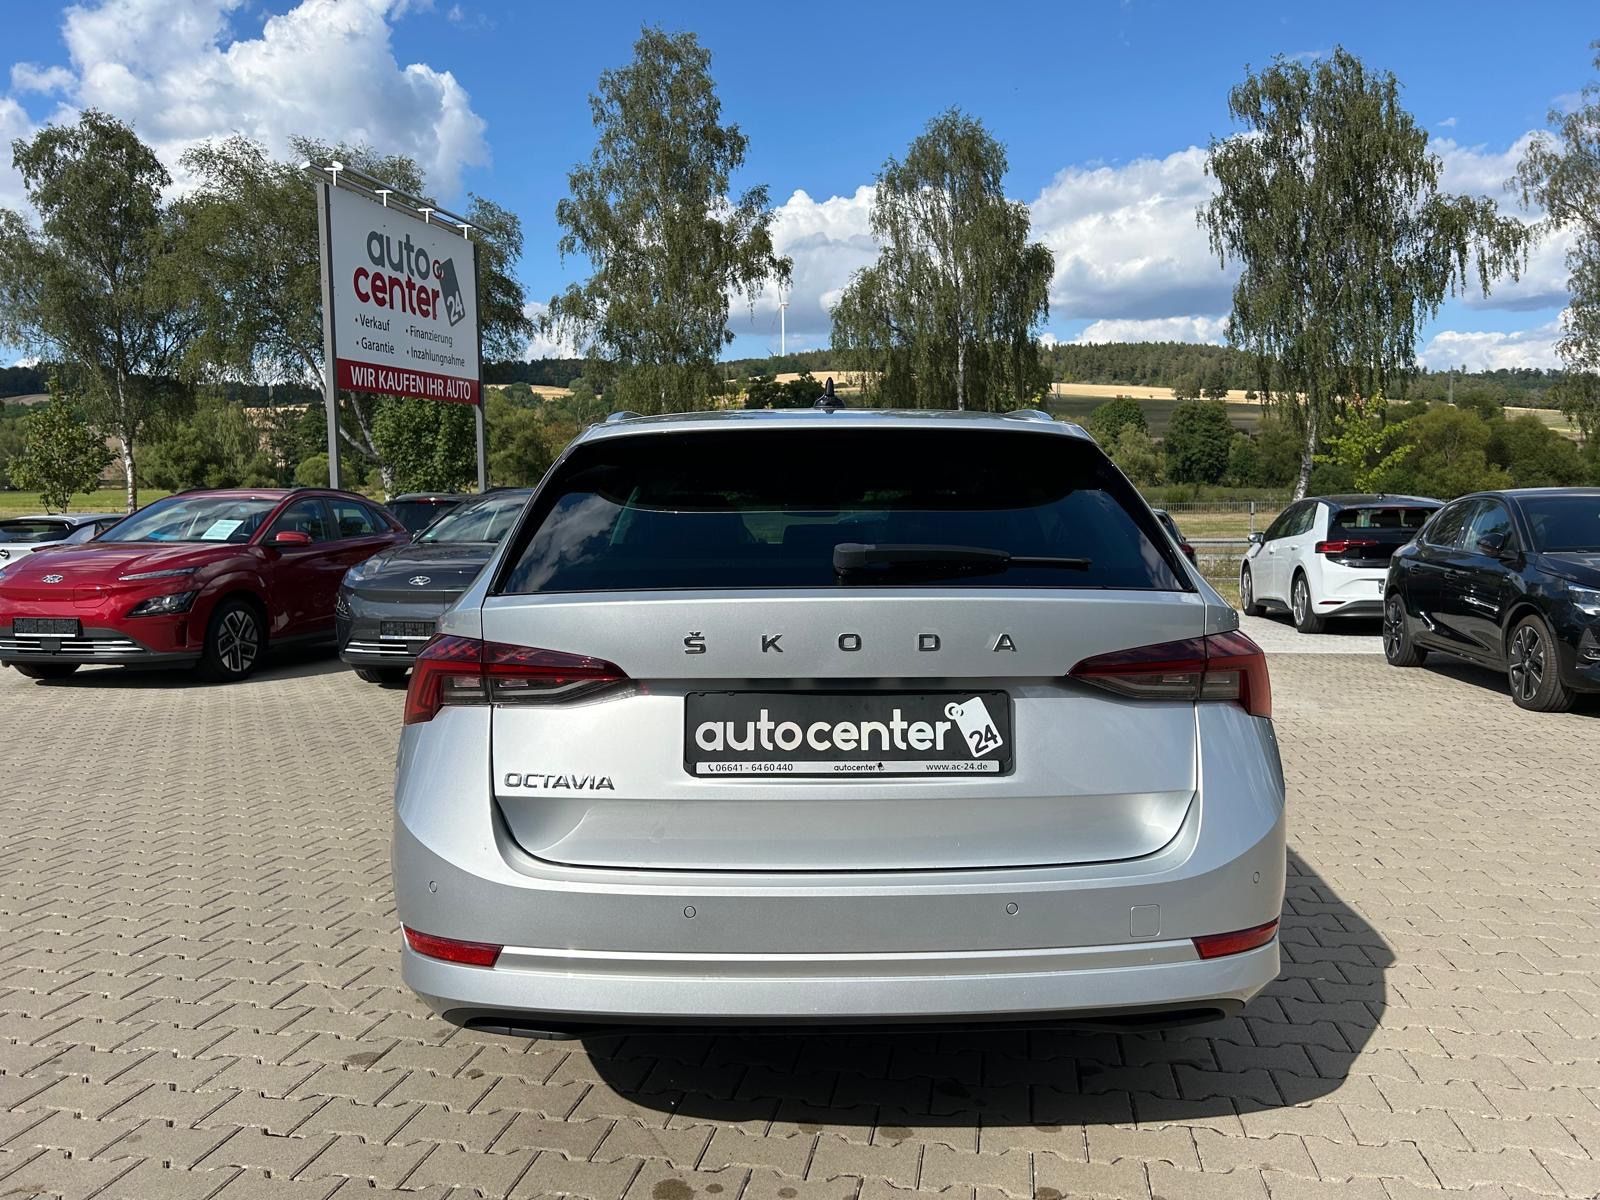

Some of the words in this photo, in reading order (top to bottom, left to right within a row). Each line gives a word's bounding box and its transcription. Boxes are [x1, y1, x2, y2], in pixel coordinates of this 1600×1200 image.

[366, 230, 430, 280] auto
[353, 266, 440, 320] center
[446, 290, 463, 321] 24
[359, 313, 390, 332] Verkauf
[361, 338, 395, 355] Garantie
[409, 325, 453, 348] Finanzierung
[410, 346, 465, 368] Inzahlungnahme
[350, 365, 376, 388] WIR
[378, 370, 424, 394] KAUFEN
[426, 378, 444, 397] IHR
[446, 380, 471, 400] AUTO
[968, 724, 998, 755] 24
[833, 763, 876, 772] autocenter
[925, 762, 988, 772] www.ac-24.de
[504, 772, 615, 791] OCTAVIA
